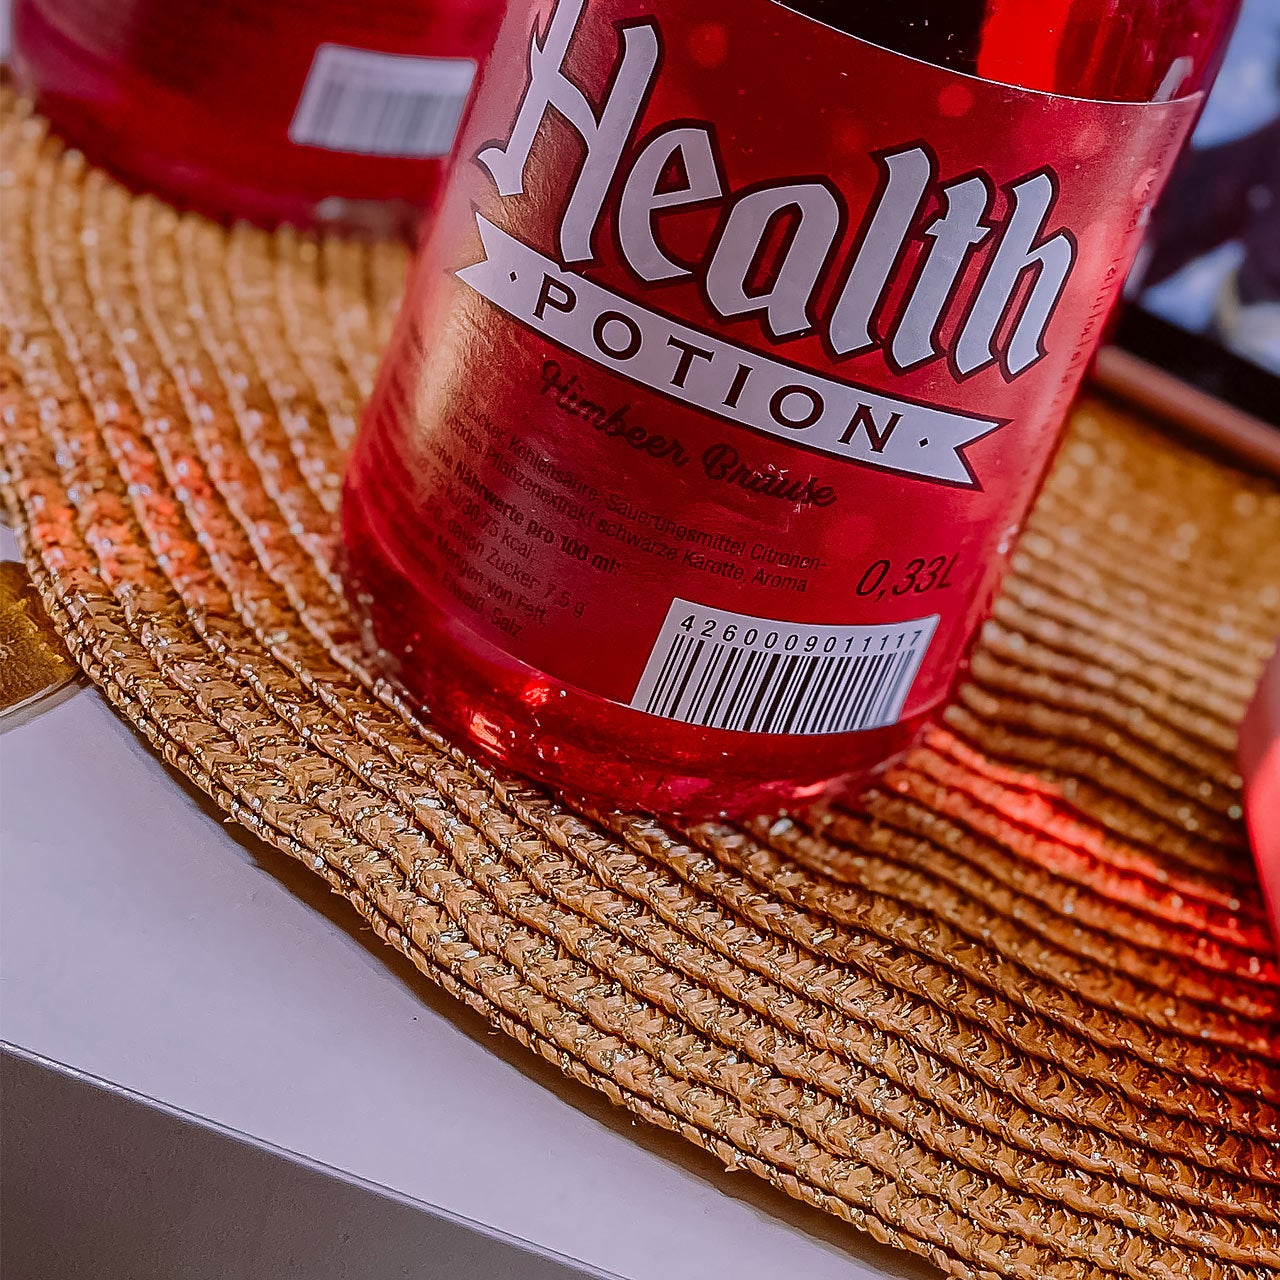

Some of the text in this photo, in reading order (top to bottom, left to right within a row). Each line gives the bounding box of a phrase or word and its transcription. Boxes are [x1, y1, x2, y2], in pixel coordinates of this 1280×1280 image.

[532, 272, 903, 453] POTION
[541, 360, 837, 507] Himbeer Brause
[525, 518, 554, 544] pro
[560, 535, 589, 562] 100
[597, 520, 680, 562] schwarze
[682, 548, 748, 584] Karotte,
[750, 568, 808, 593] Aroma
[750, 543, 828, 571] Citronen-
[487, 578, 513, 605] von
[856, 552, 960, 603] 0,33L
[680, 614, 923, 654] 4260009011117
